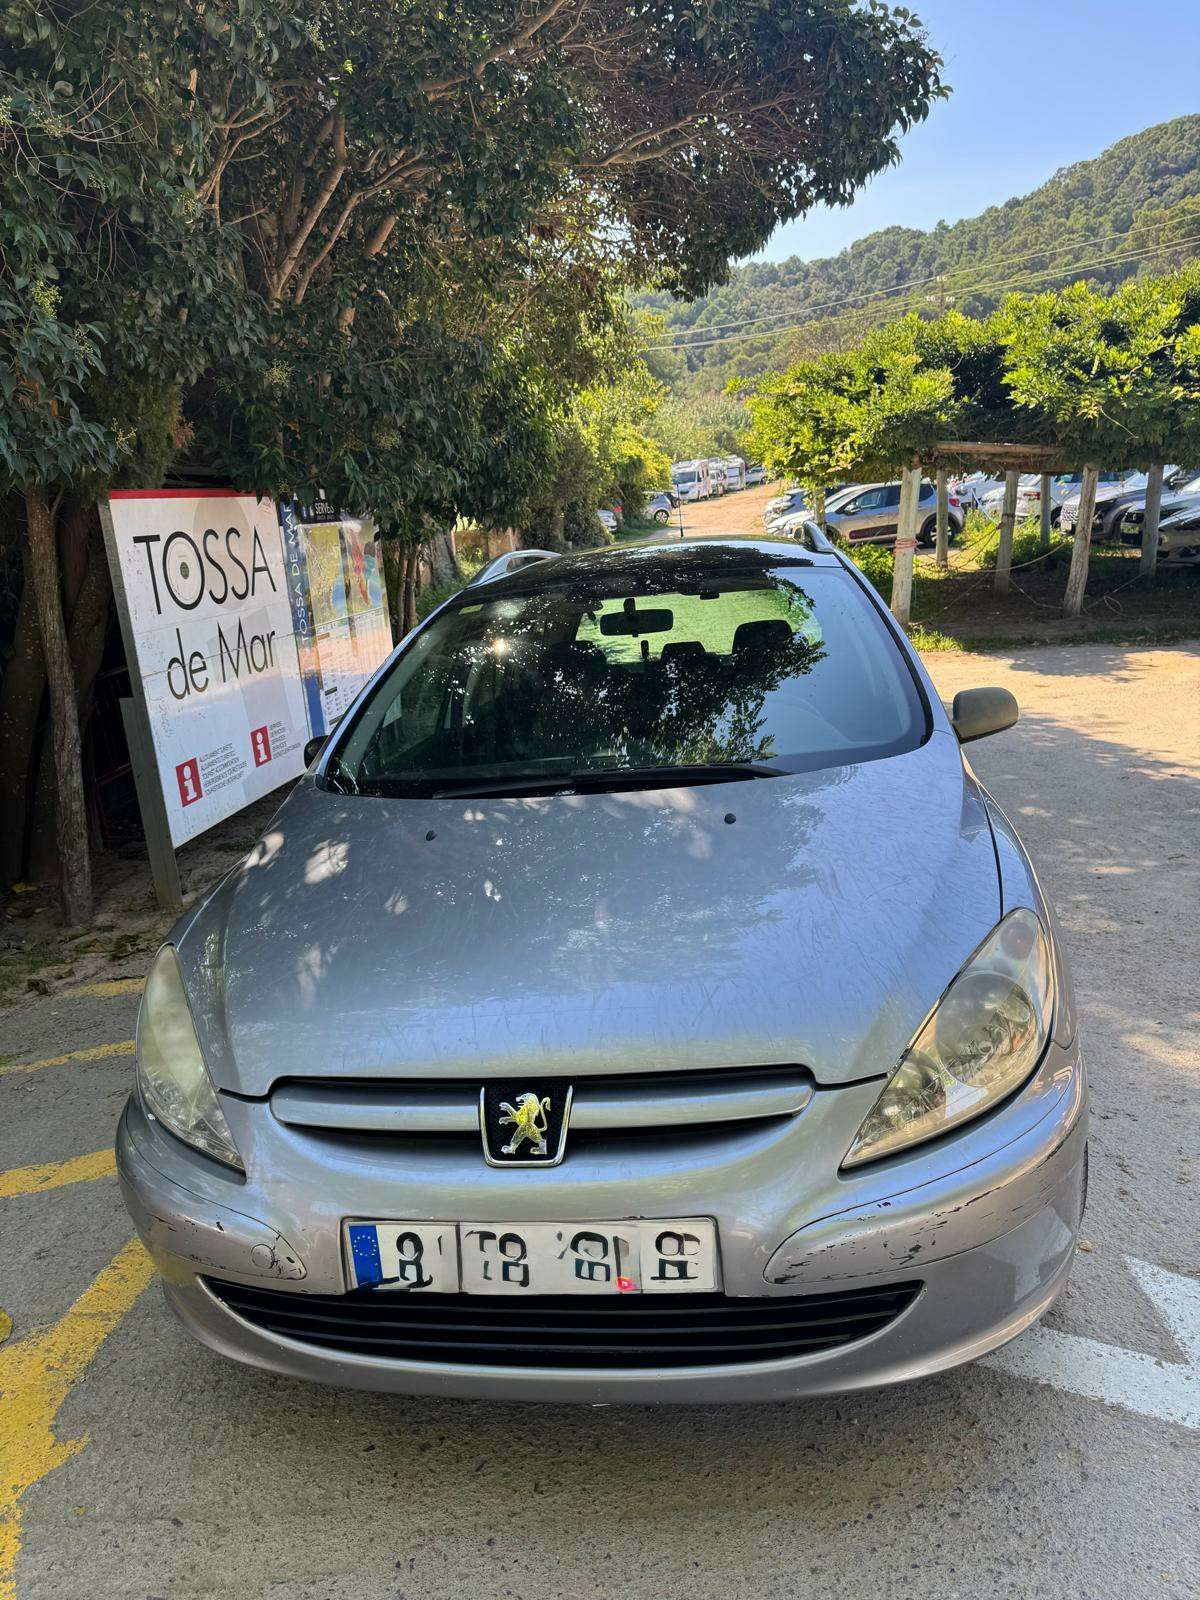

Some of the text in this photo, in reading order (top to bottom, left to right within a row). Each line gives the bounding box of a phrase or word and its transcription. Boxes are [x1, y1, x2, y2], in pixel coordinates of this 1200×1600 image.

[132, 525, 277, 615] TOSSA
[289, 553, 300, 576] DE
[294, 582, 309, 645] TOSSA
[167, 616, 276, 700] de Mar
